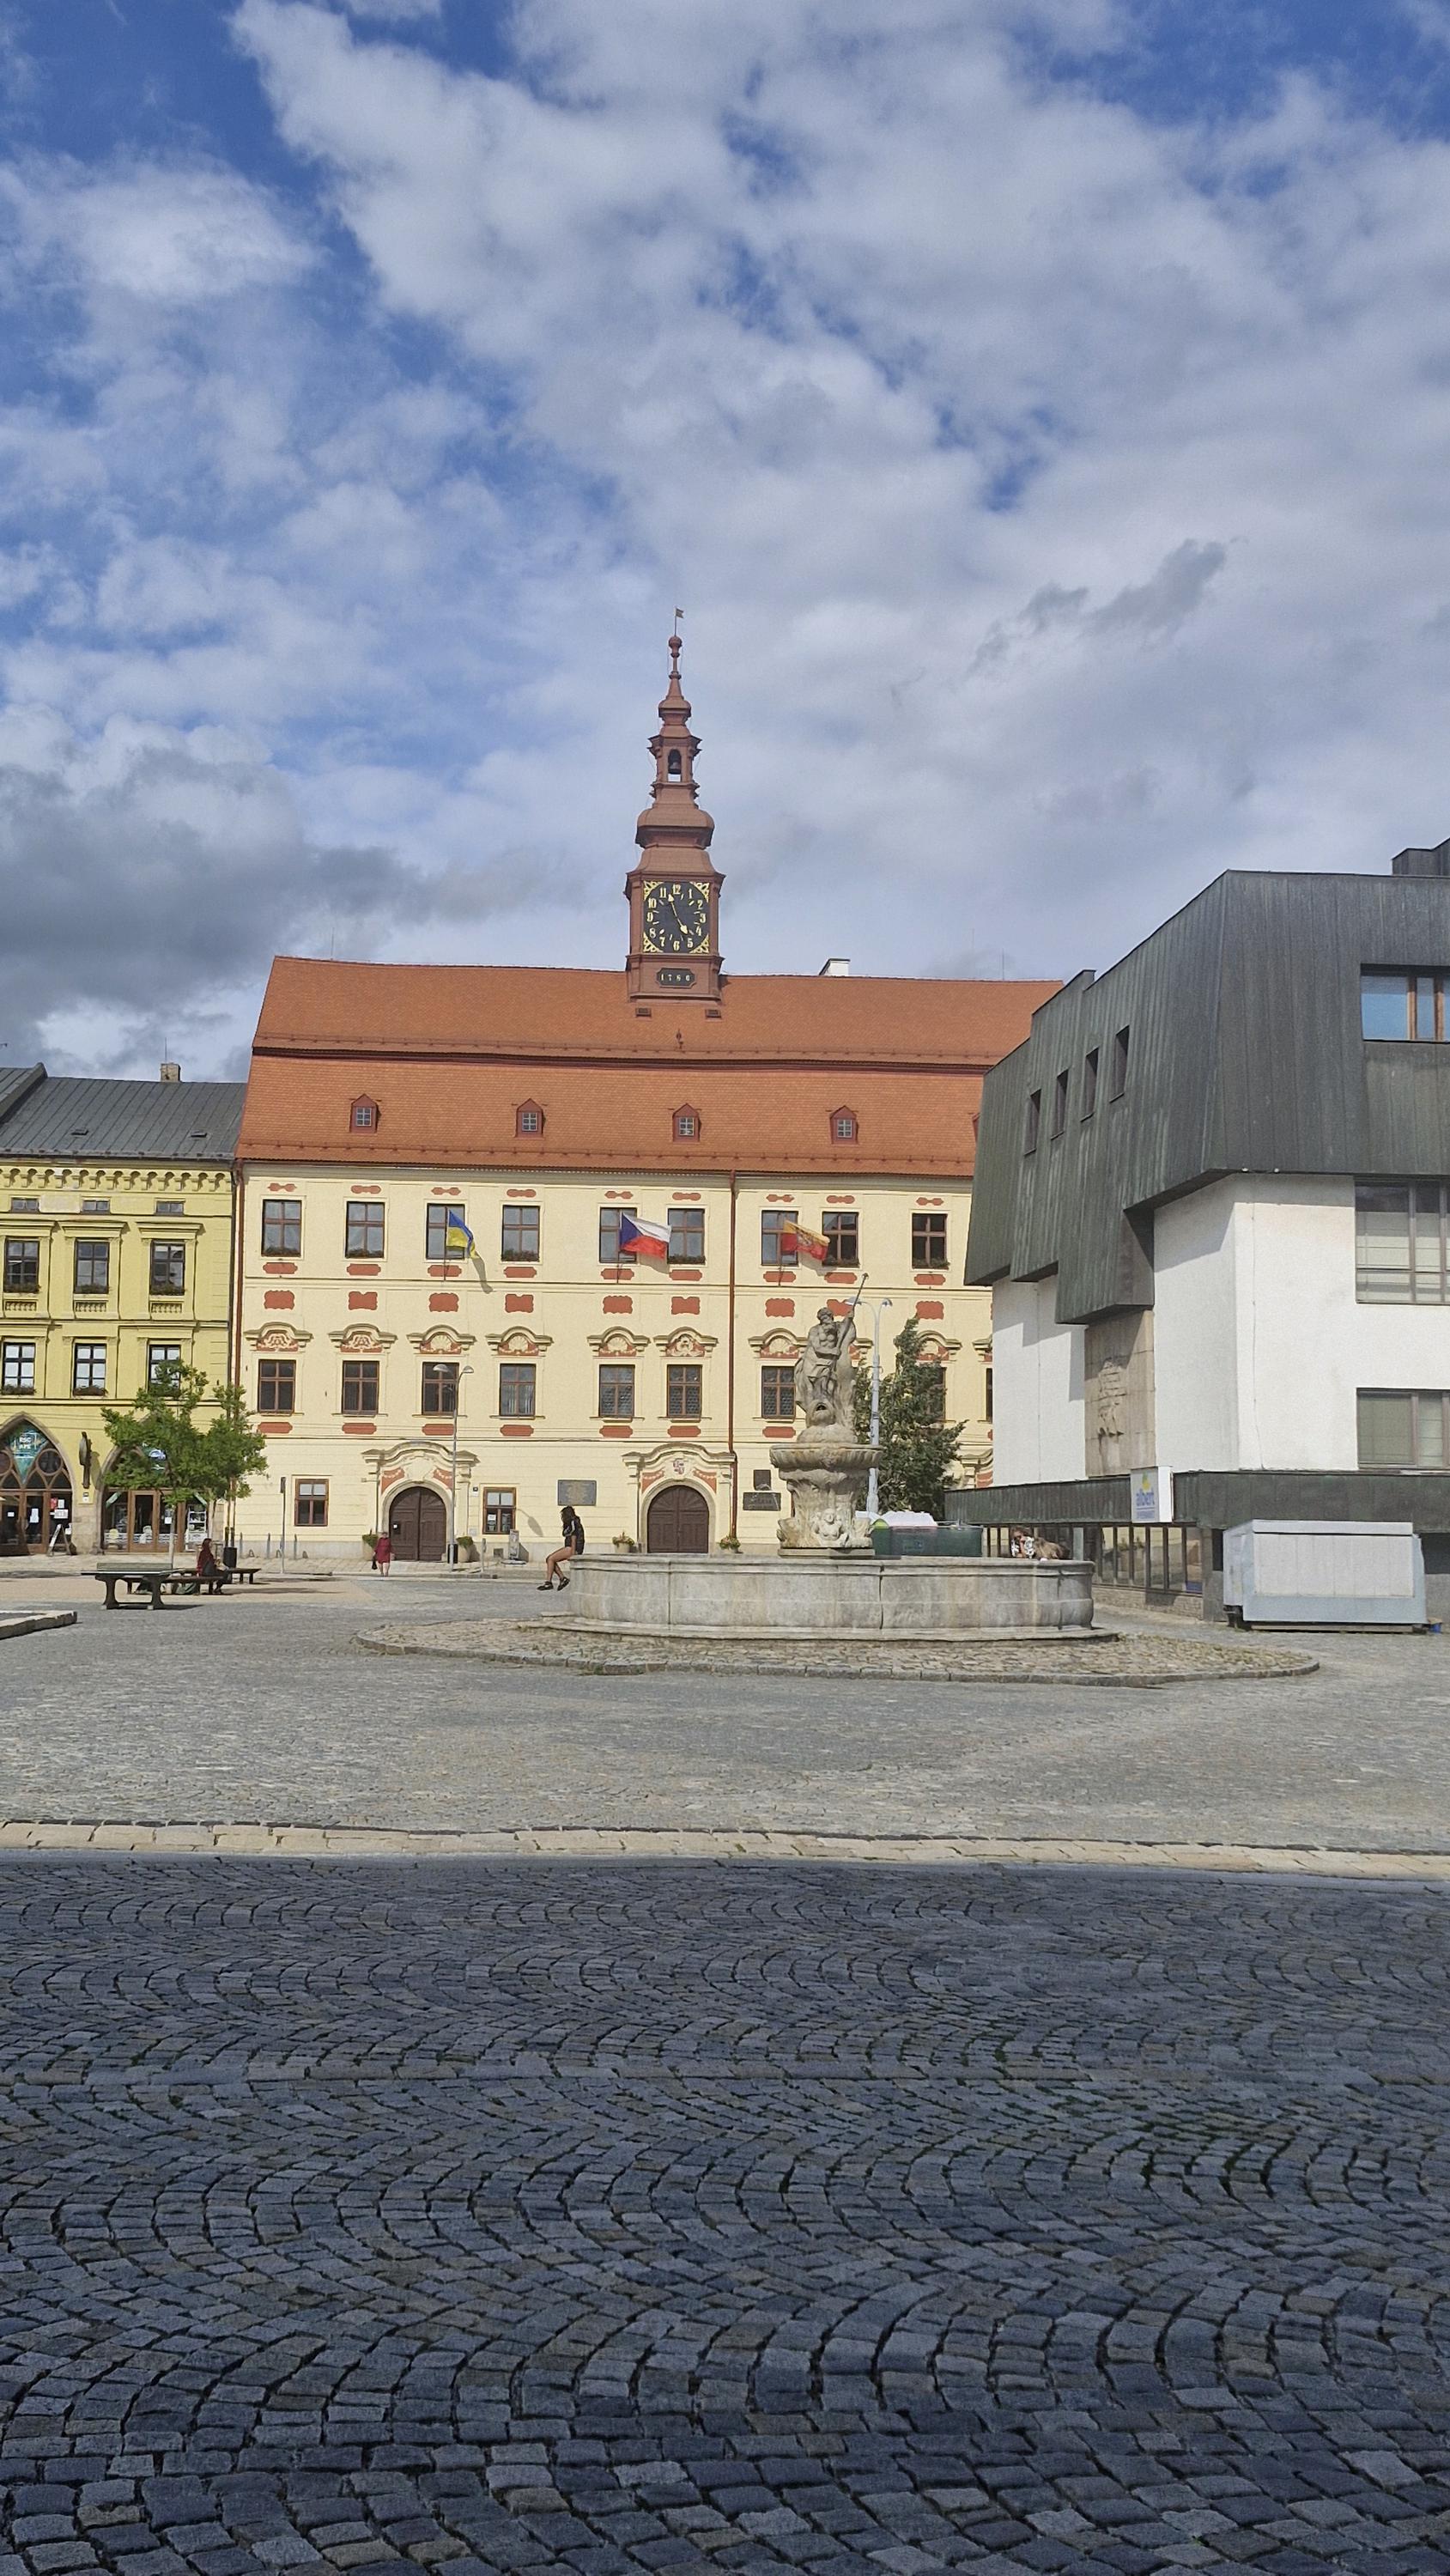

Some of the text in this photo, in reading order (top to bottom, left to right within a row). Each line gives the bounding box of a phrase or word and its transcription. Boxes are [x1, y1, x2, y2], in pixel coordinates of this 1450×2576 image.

[659, 887, 667, 898] 11
[672, 884, 681, 894] 12
[689, 888, 692, 899] 1
[648, 897, 657, 908] 10
[697, 899, 703, 909] 2
[646, 912, 653, 922] 9
[700, 913, 706, 923] 3
[649, 927, 656, 938] 8
[695, 926, 701, 936] 4
[659, 936, 665, 947] 7
[673, 940, 680, 951] 6
[687, 938, 693, 948] 5
[1136, 1487, 1155, 1506] albert
